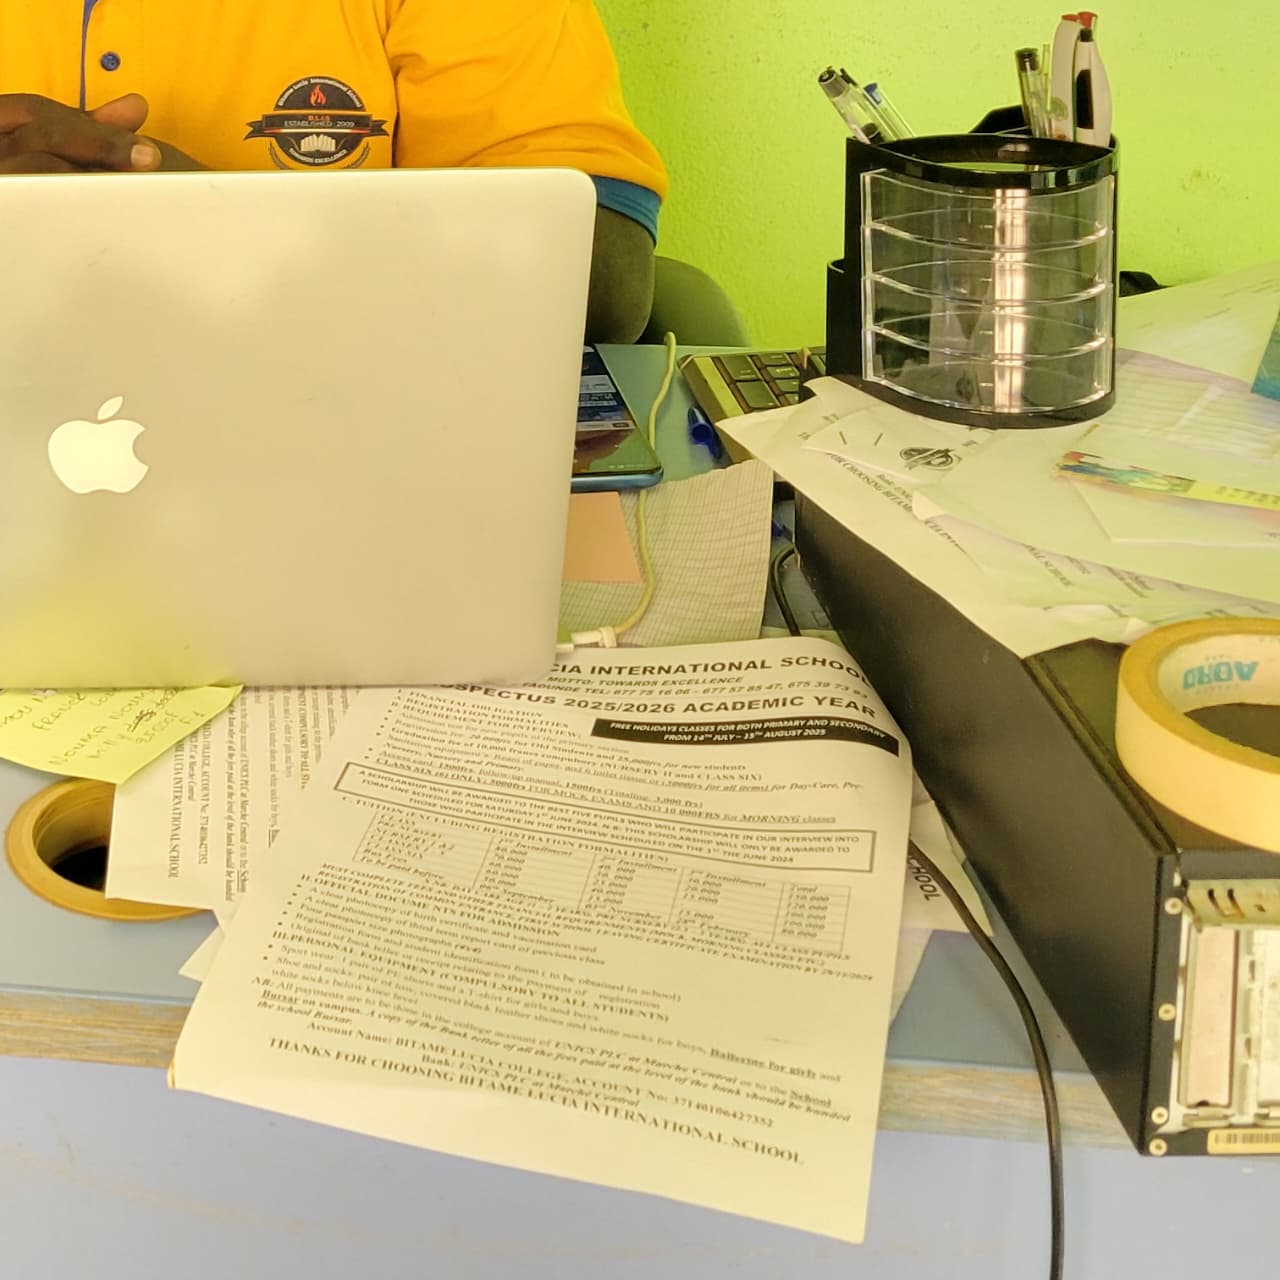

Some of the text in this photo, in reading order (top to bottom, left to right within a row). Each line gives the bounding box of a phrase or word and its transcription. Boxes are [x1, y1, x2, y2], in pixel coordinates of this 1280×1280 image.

[590, 659, 773, 676] INTERNATIONAL
[1183, 660, 1260, 690] ABRO
[547, 676, 594, 685] MOTTO:
[661, 676, 743, 686] EXCELLENCE
[563, 698, 675, 713] 2025/2026
[683, 696, 805, 713] ACADEMIC
[813, 696, 877, 718] YEAR
[610, 722, 632, 730] FREE
[632, 724, 677, 732] HOLIDAYS
[678, 724, 714, 732] CLASSES
[736, 722, 763, 730] BOTH
[764, 720, 809, 728] PRIMARY
[830, 720, 886, 738] SECONDARY
[664, 734, 692, 742] FROM
[764, 729, 803, 738] AUGUST
[804, 728, 826, 736] 2025
[168, 777, 183, 879] INTERNATIONAL SCHOOL
[740, 815, 800, 823] MORNING
[269, 1038, 331, 1058] THANKS
[335, 1050, 367, 1066] FOR
[371, 1058, 454, 1082] CHOOSING
[584, 1100, 728, 1145] INTERNATIONAL
[732, 1137, 805, 1164] SCHOOL
